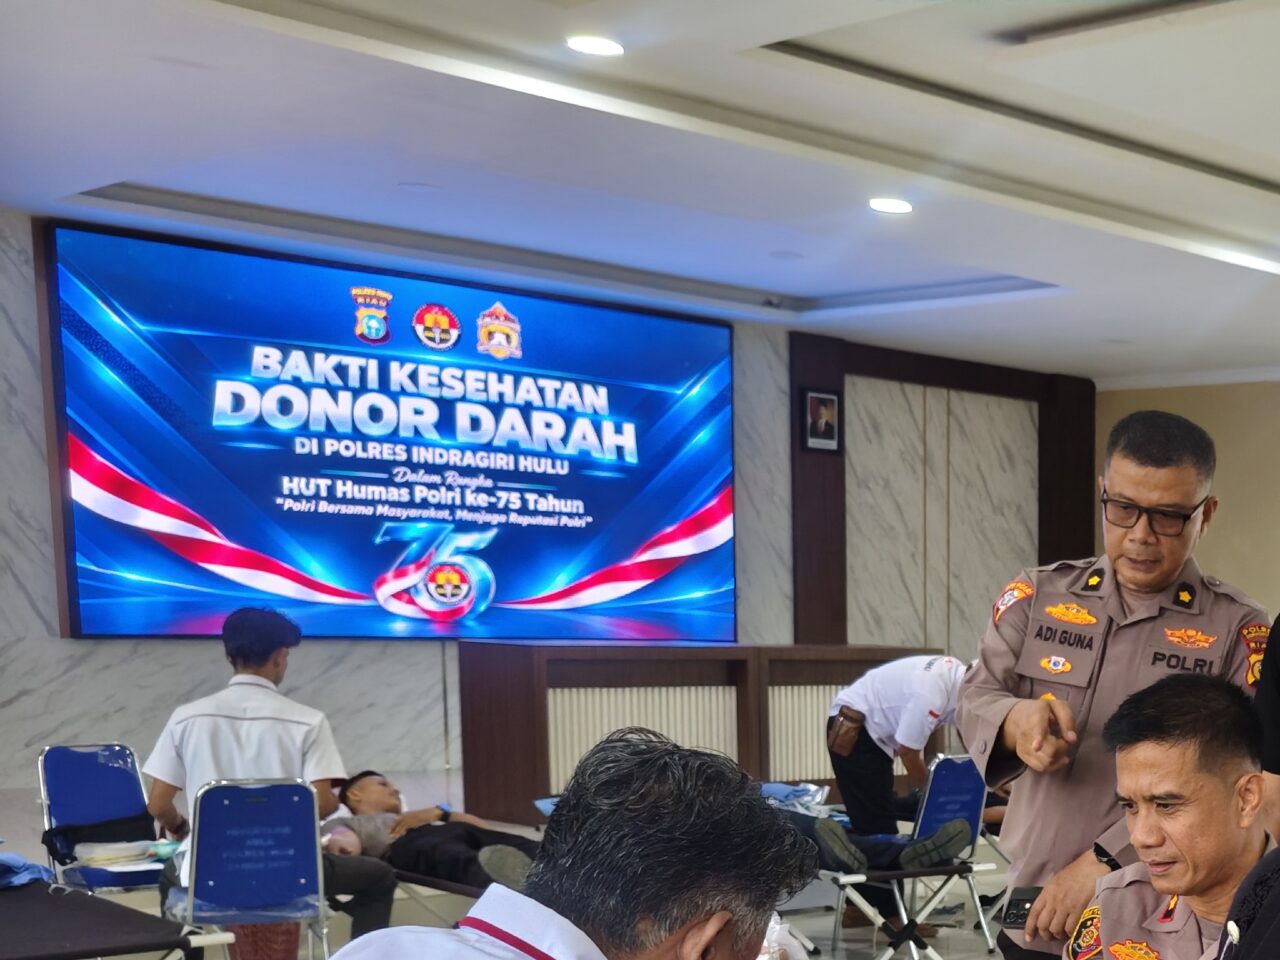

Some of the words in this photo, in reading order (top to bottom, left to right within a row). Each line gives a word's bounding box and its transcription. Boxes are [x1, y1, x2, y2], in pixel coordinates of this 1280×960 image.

[251, 346, 379, 390] BAKTI
[390, 361, 609, 415] KESEHATAN
[212, 380, 440, 440] DONOR
[456, 401, 638, 464] DARAH
[294, 437, 319, 455] DI
[324, 438, 407, 462] POLRES
[411, 446, 515, 470] INDRAGIRI
[518, 455, 569, 475] HULU
[392, 466, 443, 484] Dalam
[281, 476, 332, 497] HUT
[335, 480, 411, 503] Humas
[414, 485, 461, 506] Polri
[465, 488, 522, 510] ke-75
[523, 493, 585, 514] Tahun
[317, 501, 374, 516] Bersama
[1034, 625, 1058, 643] ADI
[1059, 630, 1093, 651] GUNA
[1151, 651, 1214, 675] POLRI
